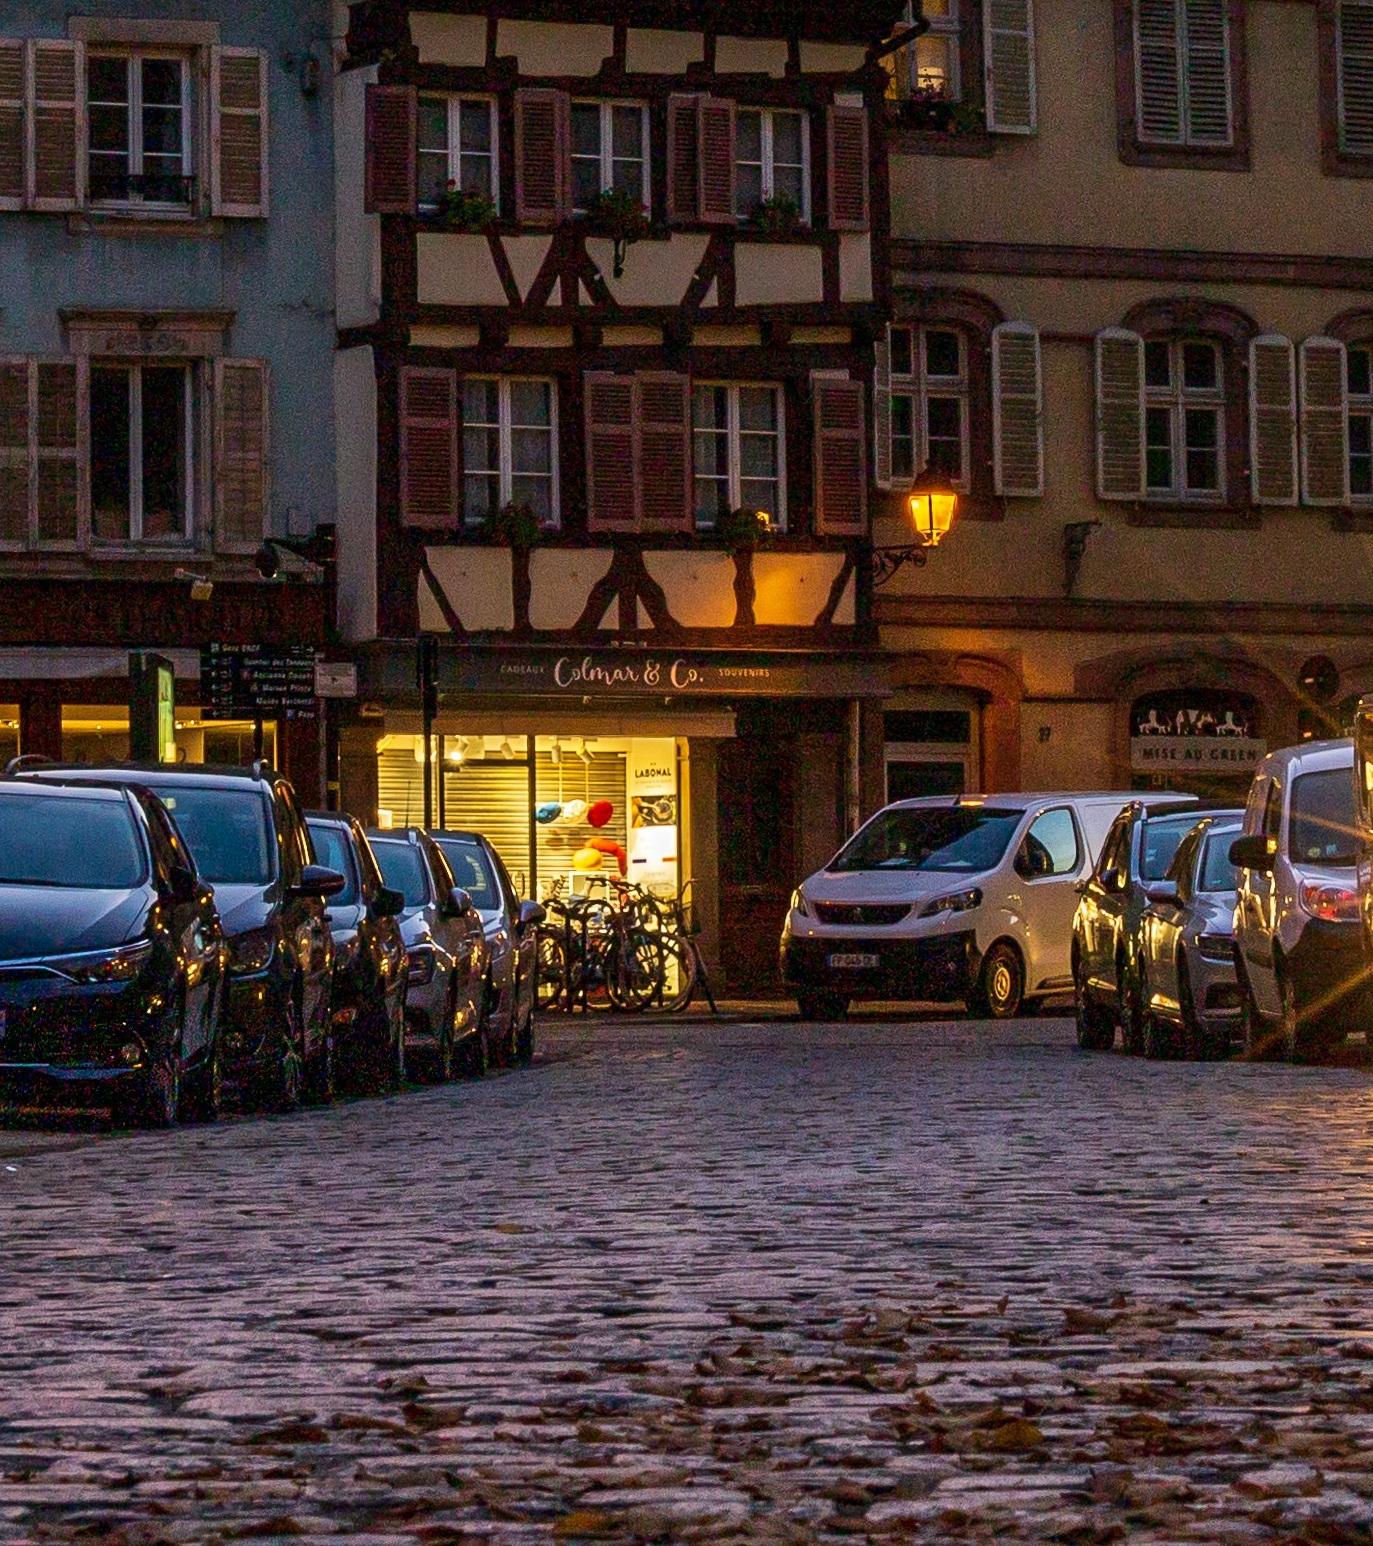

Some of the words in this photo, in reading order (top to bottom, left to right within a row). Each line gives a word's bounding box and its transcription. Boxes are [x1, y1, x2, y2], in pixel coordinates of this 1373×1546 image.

[554, 656, 639, 688] Colmar
[643, 659, 661, 686] &
[670, 658, 704, 689] Co.
[718, 667, 770, 678] SOUVENIRS
[1142, 749, 1176, 760] MISE
[1184, 749, 1202, 760] AU
[1210, 749, 1257, 761] GREEN
[634, 767, 671, 779] LABONAL
